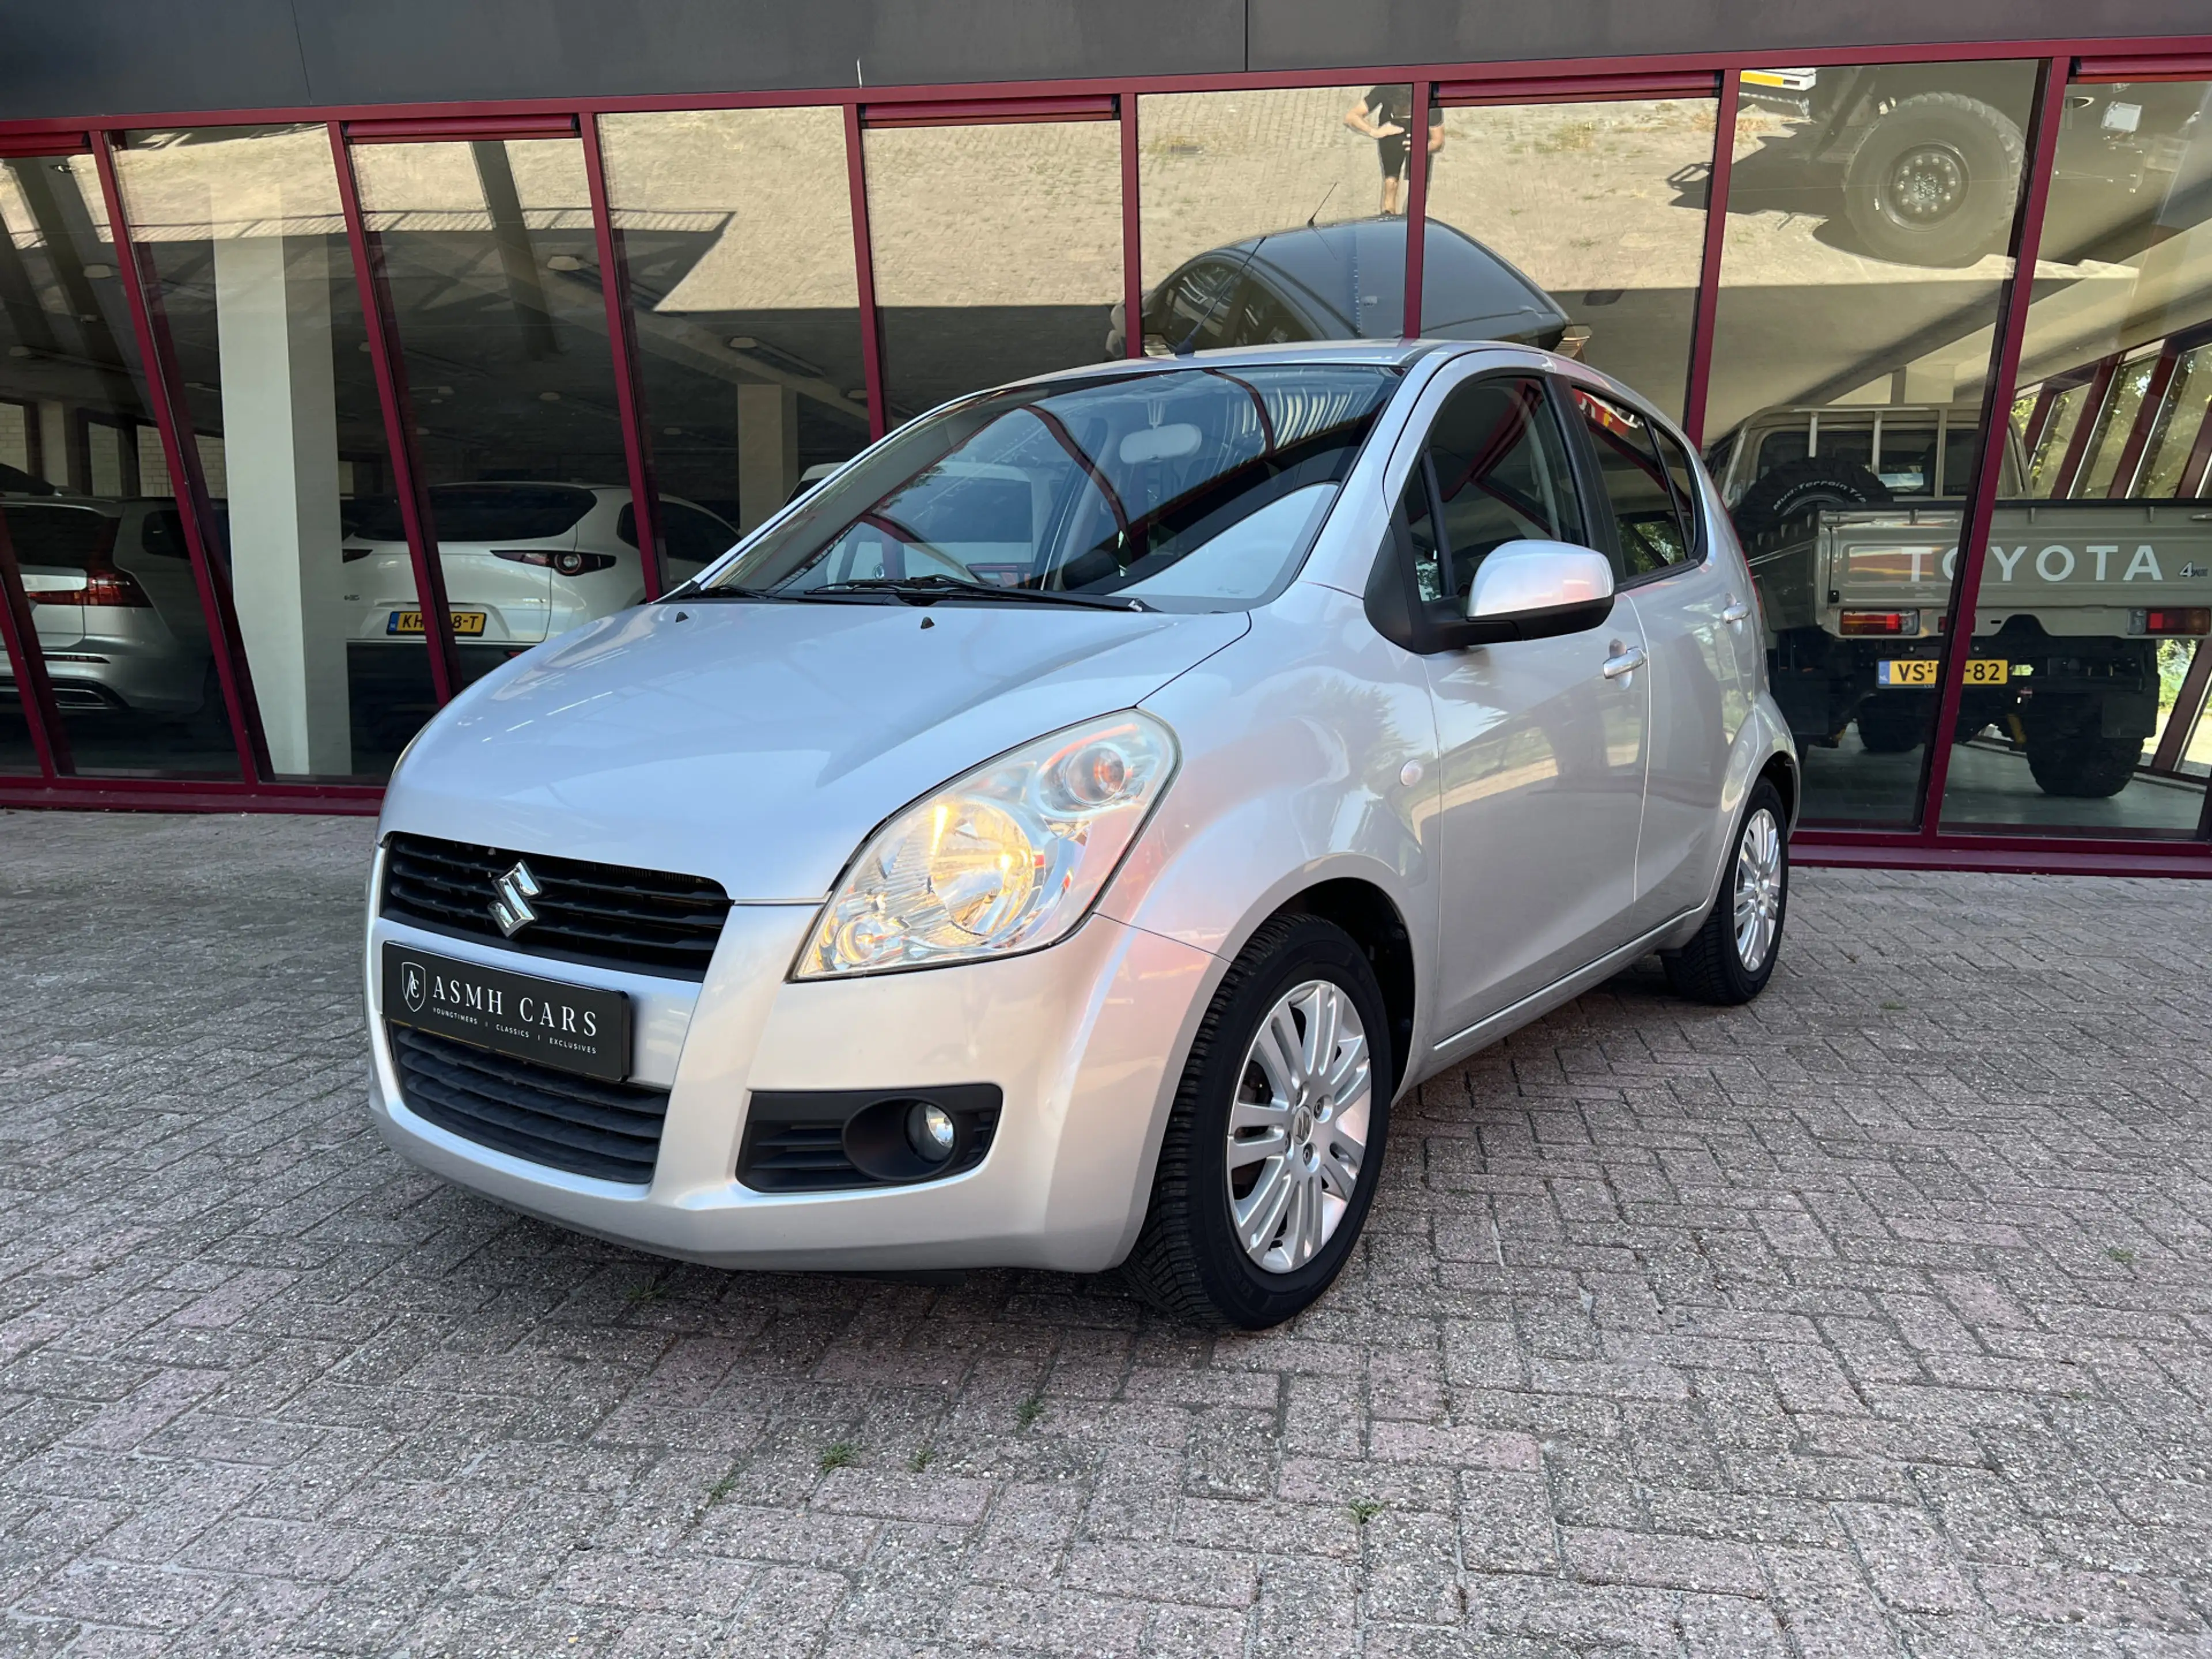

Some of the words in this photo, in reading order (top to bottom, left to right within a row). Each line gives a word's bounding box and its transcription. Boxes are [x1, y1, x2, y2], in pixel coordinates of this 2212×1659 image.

[402, 613, 479, 630] KH8-T
[1897, 662, 2000, 681] VS--82
[433, 975, 503, 1016] ASMH
[519, 997, 597, 1036] CARS
[433, 1007, 478, 1025] YOUNGTIMERS
[495, 1024, 530, 1038] CLASSICS
[549, 1037, 597, 1054] EXCLUSIVES
